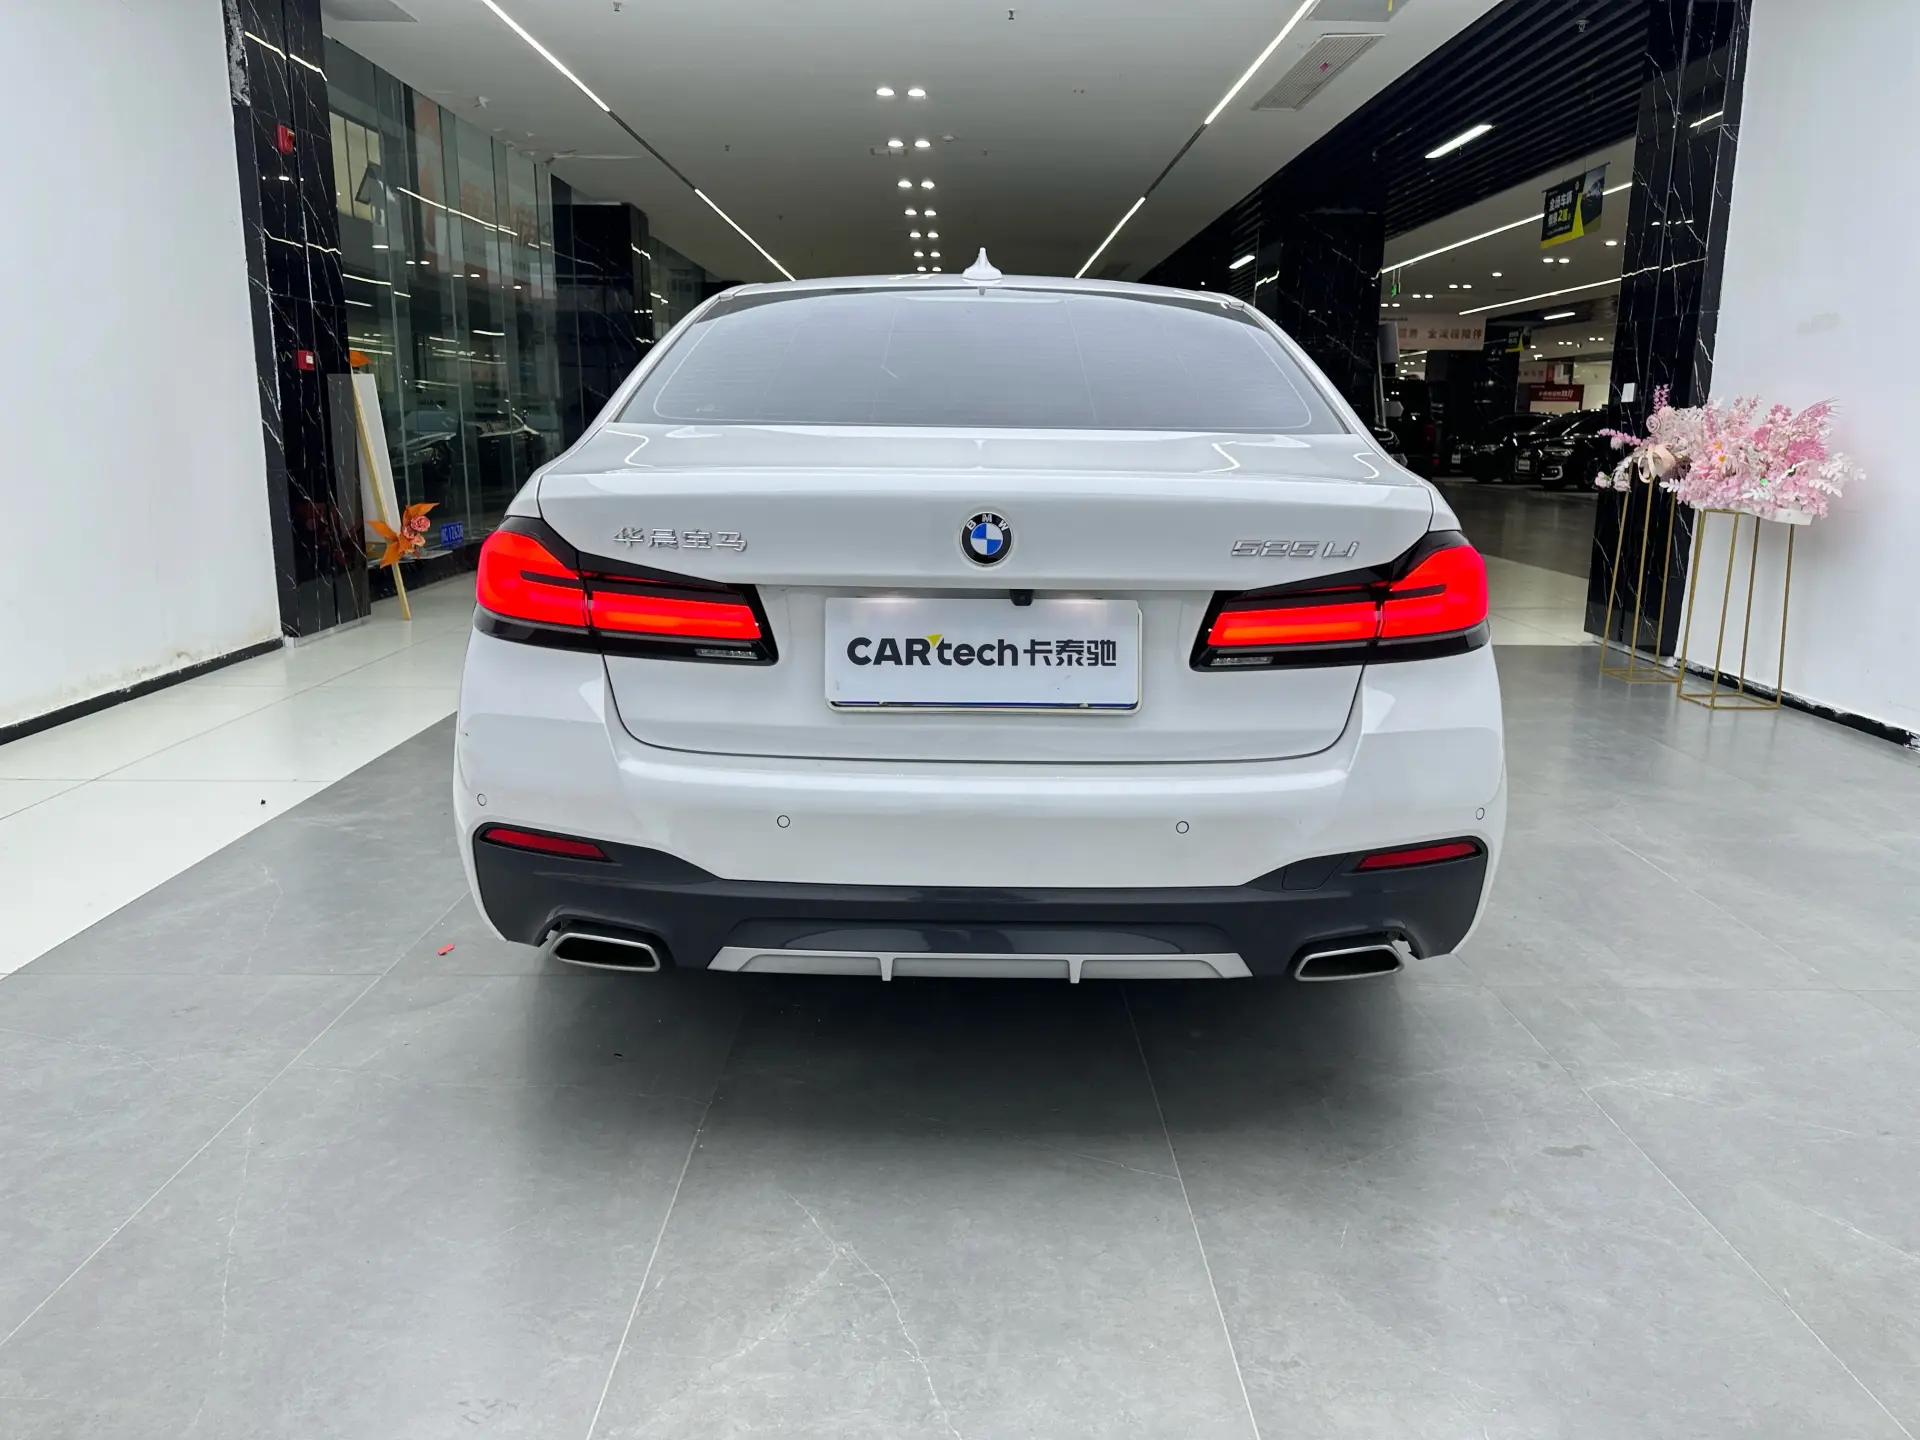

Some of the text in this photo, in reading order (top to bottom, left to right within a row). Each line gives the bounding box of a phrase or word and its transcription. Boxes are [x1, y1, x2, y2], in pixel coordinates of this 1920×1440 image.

[966, 513, 1009, 531] BMW
[613, 526, 747, 552] 华晨宝马
